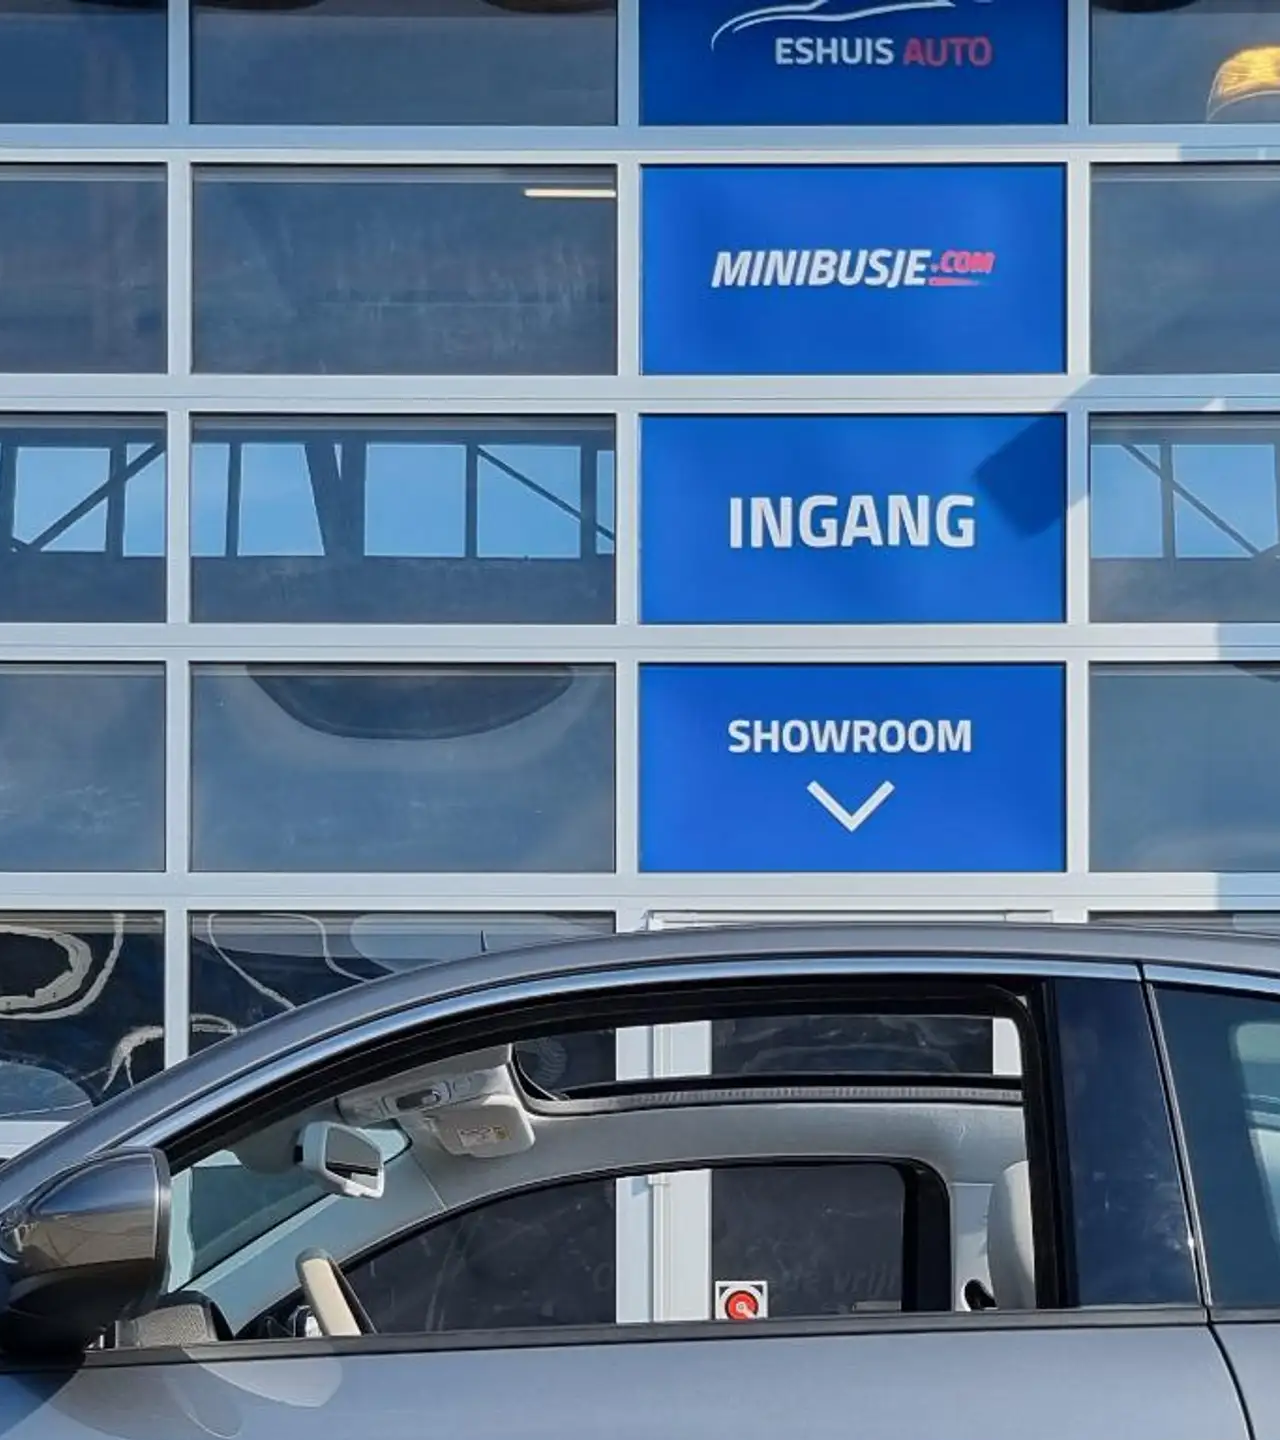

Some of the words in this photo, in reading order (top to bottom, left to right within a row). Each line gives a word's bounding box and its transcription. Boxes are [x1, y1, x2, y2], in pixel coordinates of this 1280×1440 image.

[774, 37, 894, 66] ESHUIS
[902, 37, 993, 67] AUTO
[728, 494, 976, 549] INGANG
[727, 719, 973, 753] SHOWROOM
